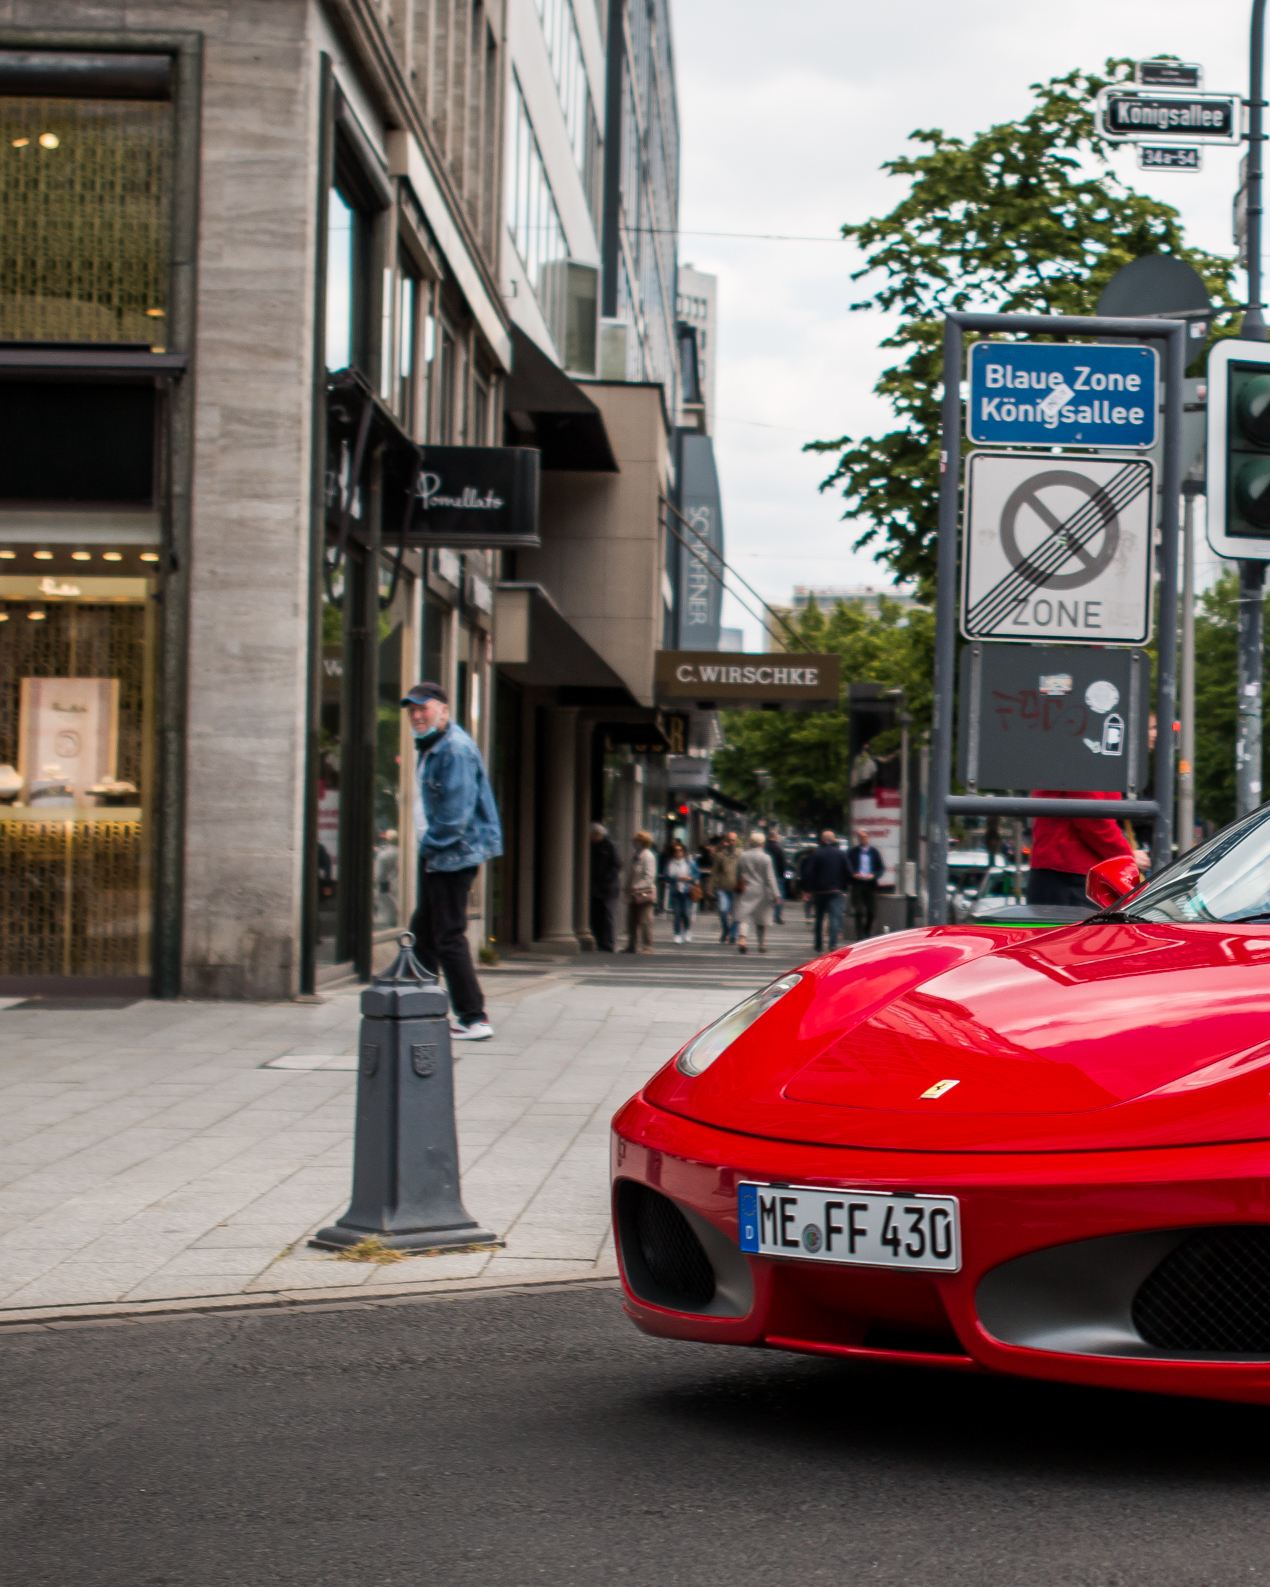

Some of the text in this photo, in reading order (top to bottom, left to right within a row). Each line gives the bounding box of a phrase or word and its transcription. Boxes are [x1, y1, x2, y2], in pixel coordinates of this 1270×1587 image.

[1117, 101, 1224, 130] Königsallee
[1145, 150, 1196, 166] 34a-54
[985, 364, 1142, 392] Blaue Zone
[981, 397, 1145, 429] Königsallee
[408, 472, 504, 510] Pomellato
[1011, 598, 1103, 629] ZONE
[745, 1225, 755, 1240] D
[759, 1194, 800, 1249] ME
[824, 1200, 869, 1255] FF
[880, 1204, 953, 1260] 430
